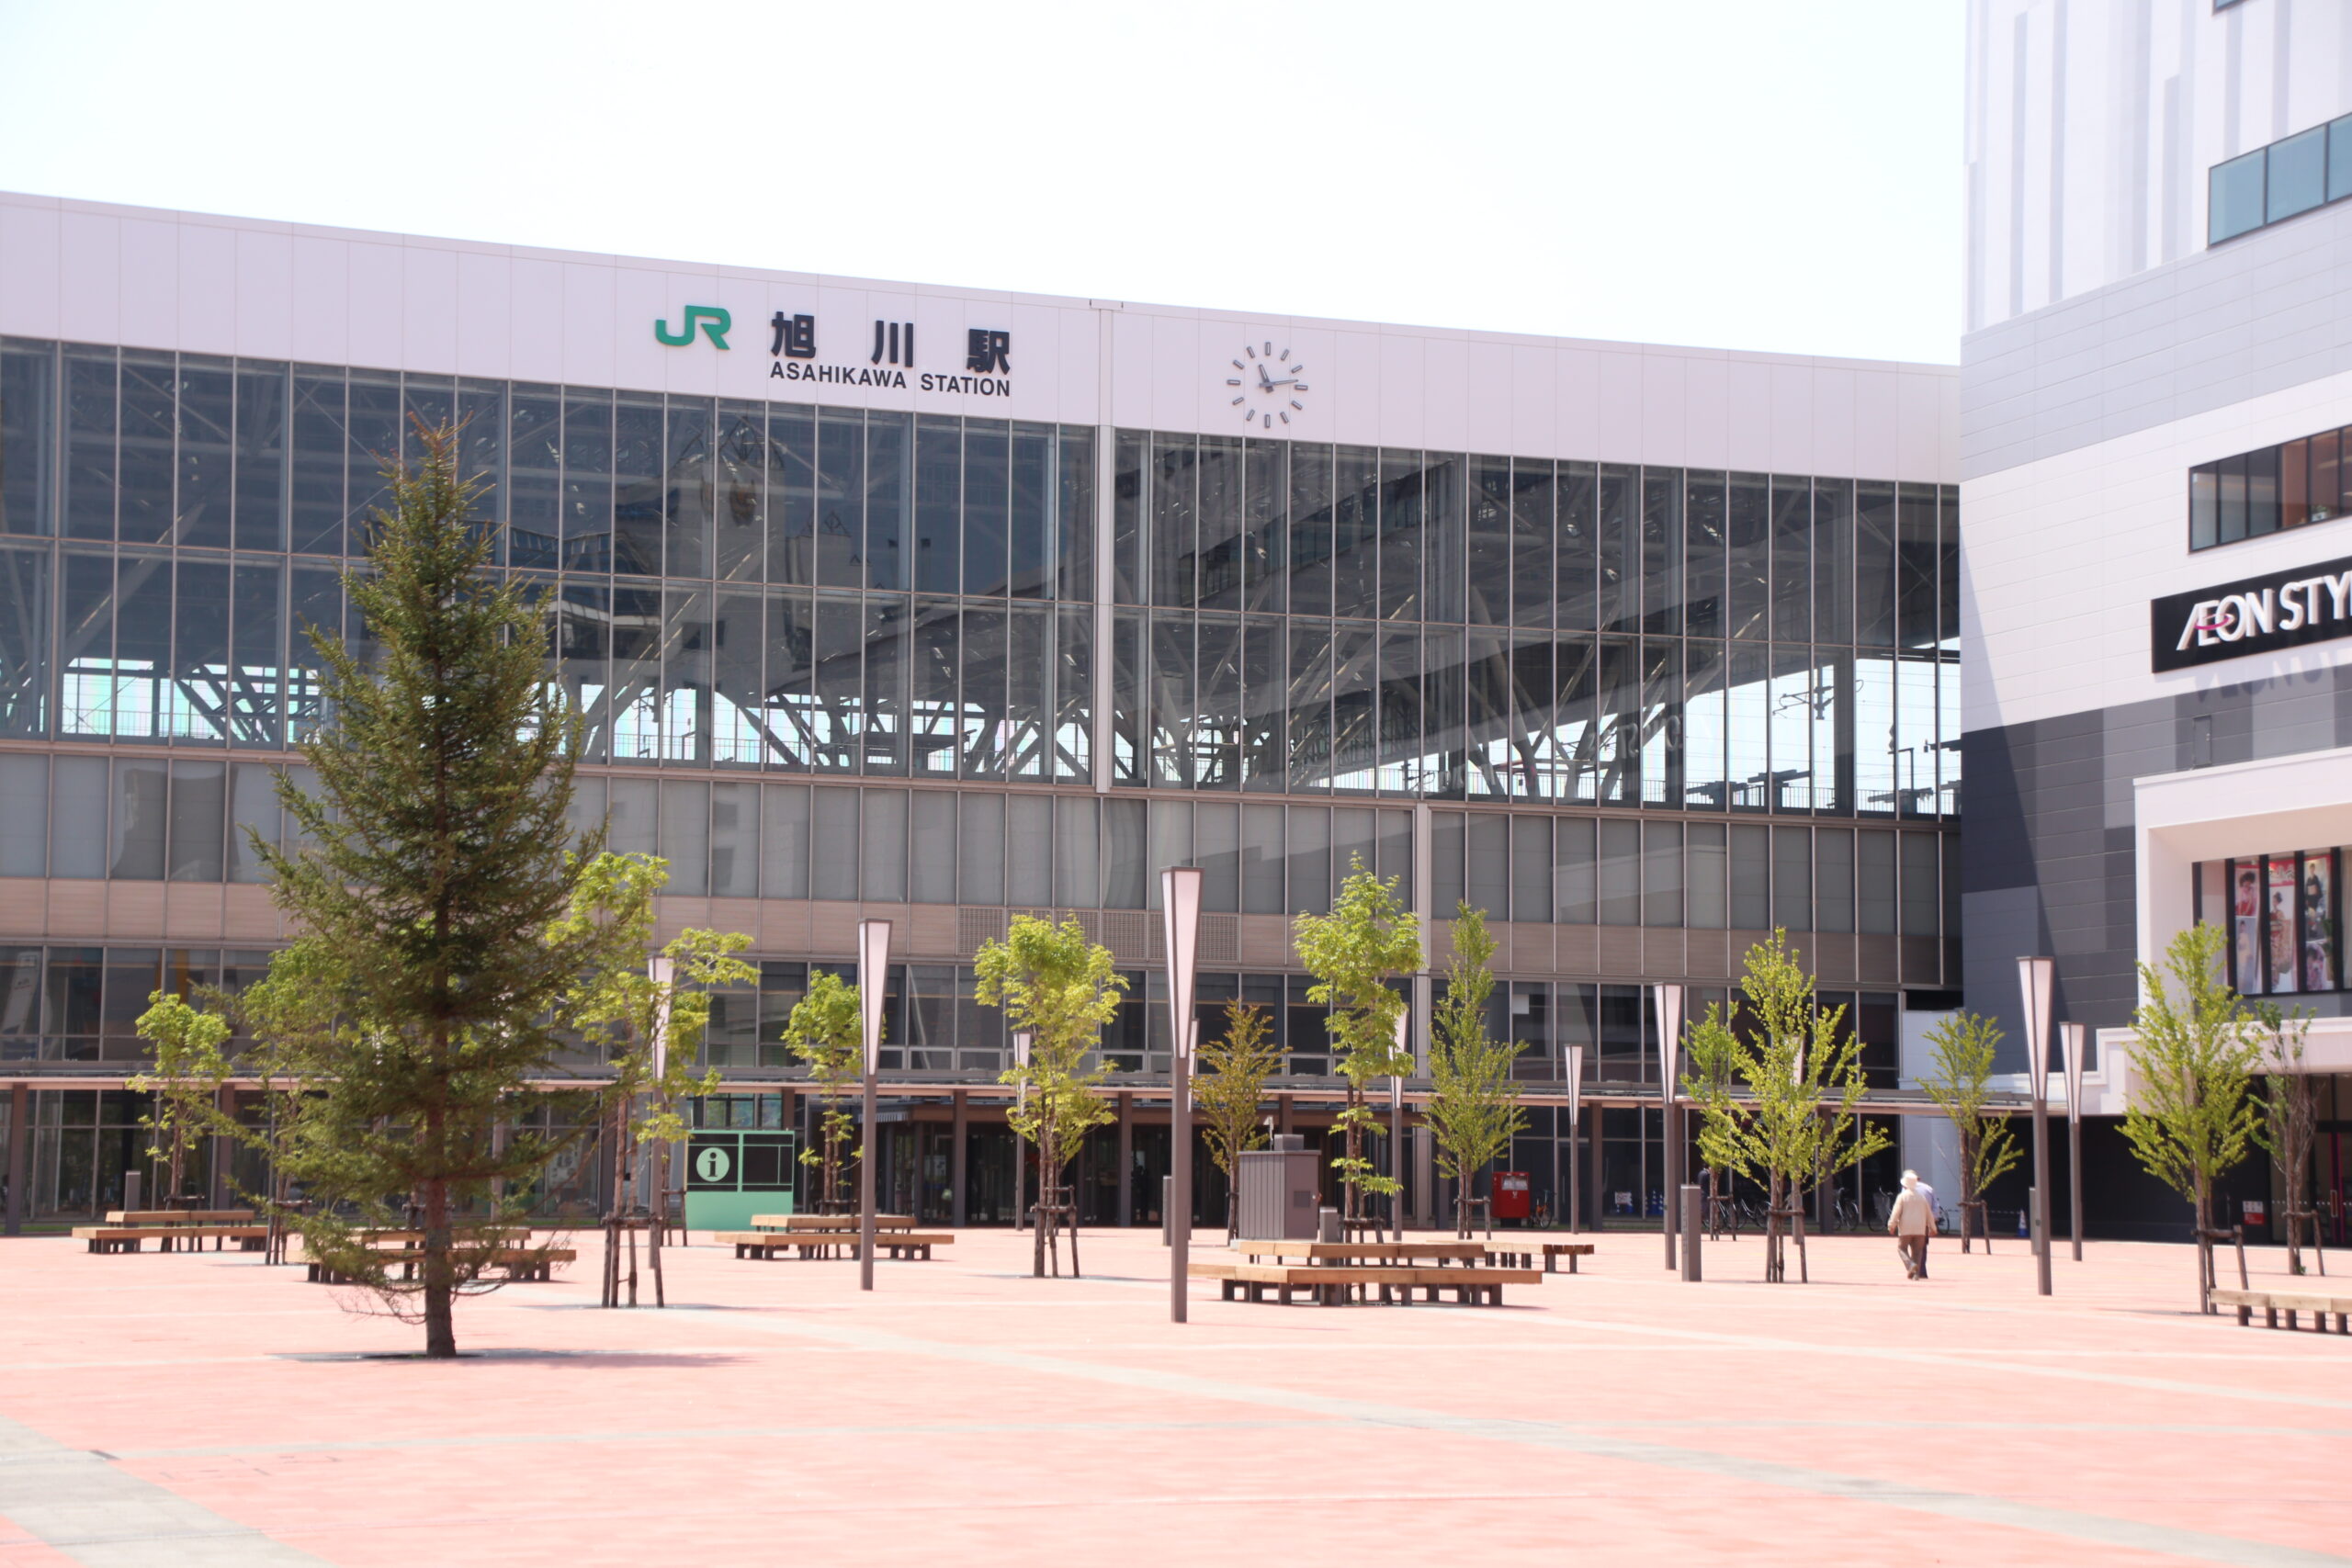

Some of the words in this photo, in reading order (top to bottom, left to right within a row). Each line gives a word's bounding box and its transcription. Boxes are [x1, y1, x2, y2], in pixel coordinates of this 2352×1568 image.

[655, 304, 731, 350] JR
[770, 310, 1011, 376] 旭川駅
[770, 361, 907, 389] ASAHIKAWA
[921, 373, 1010, 397] STATION
[2278, 570, 2352, 630] STY
